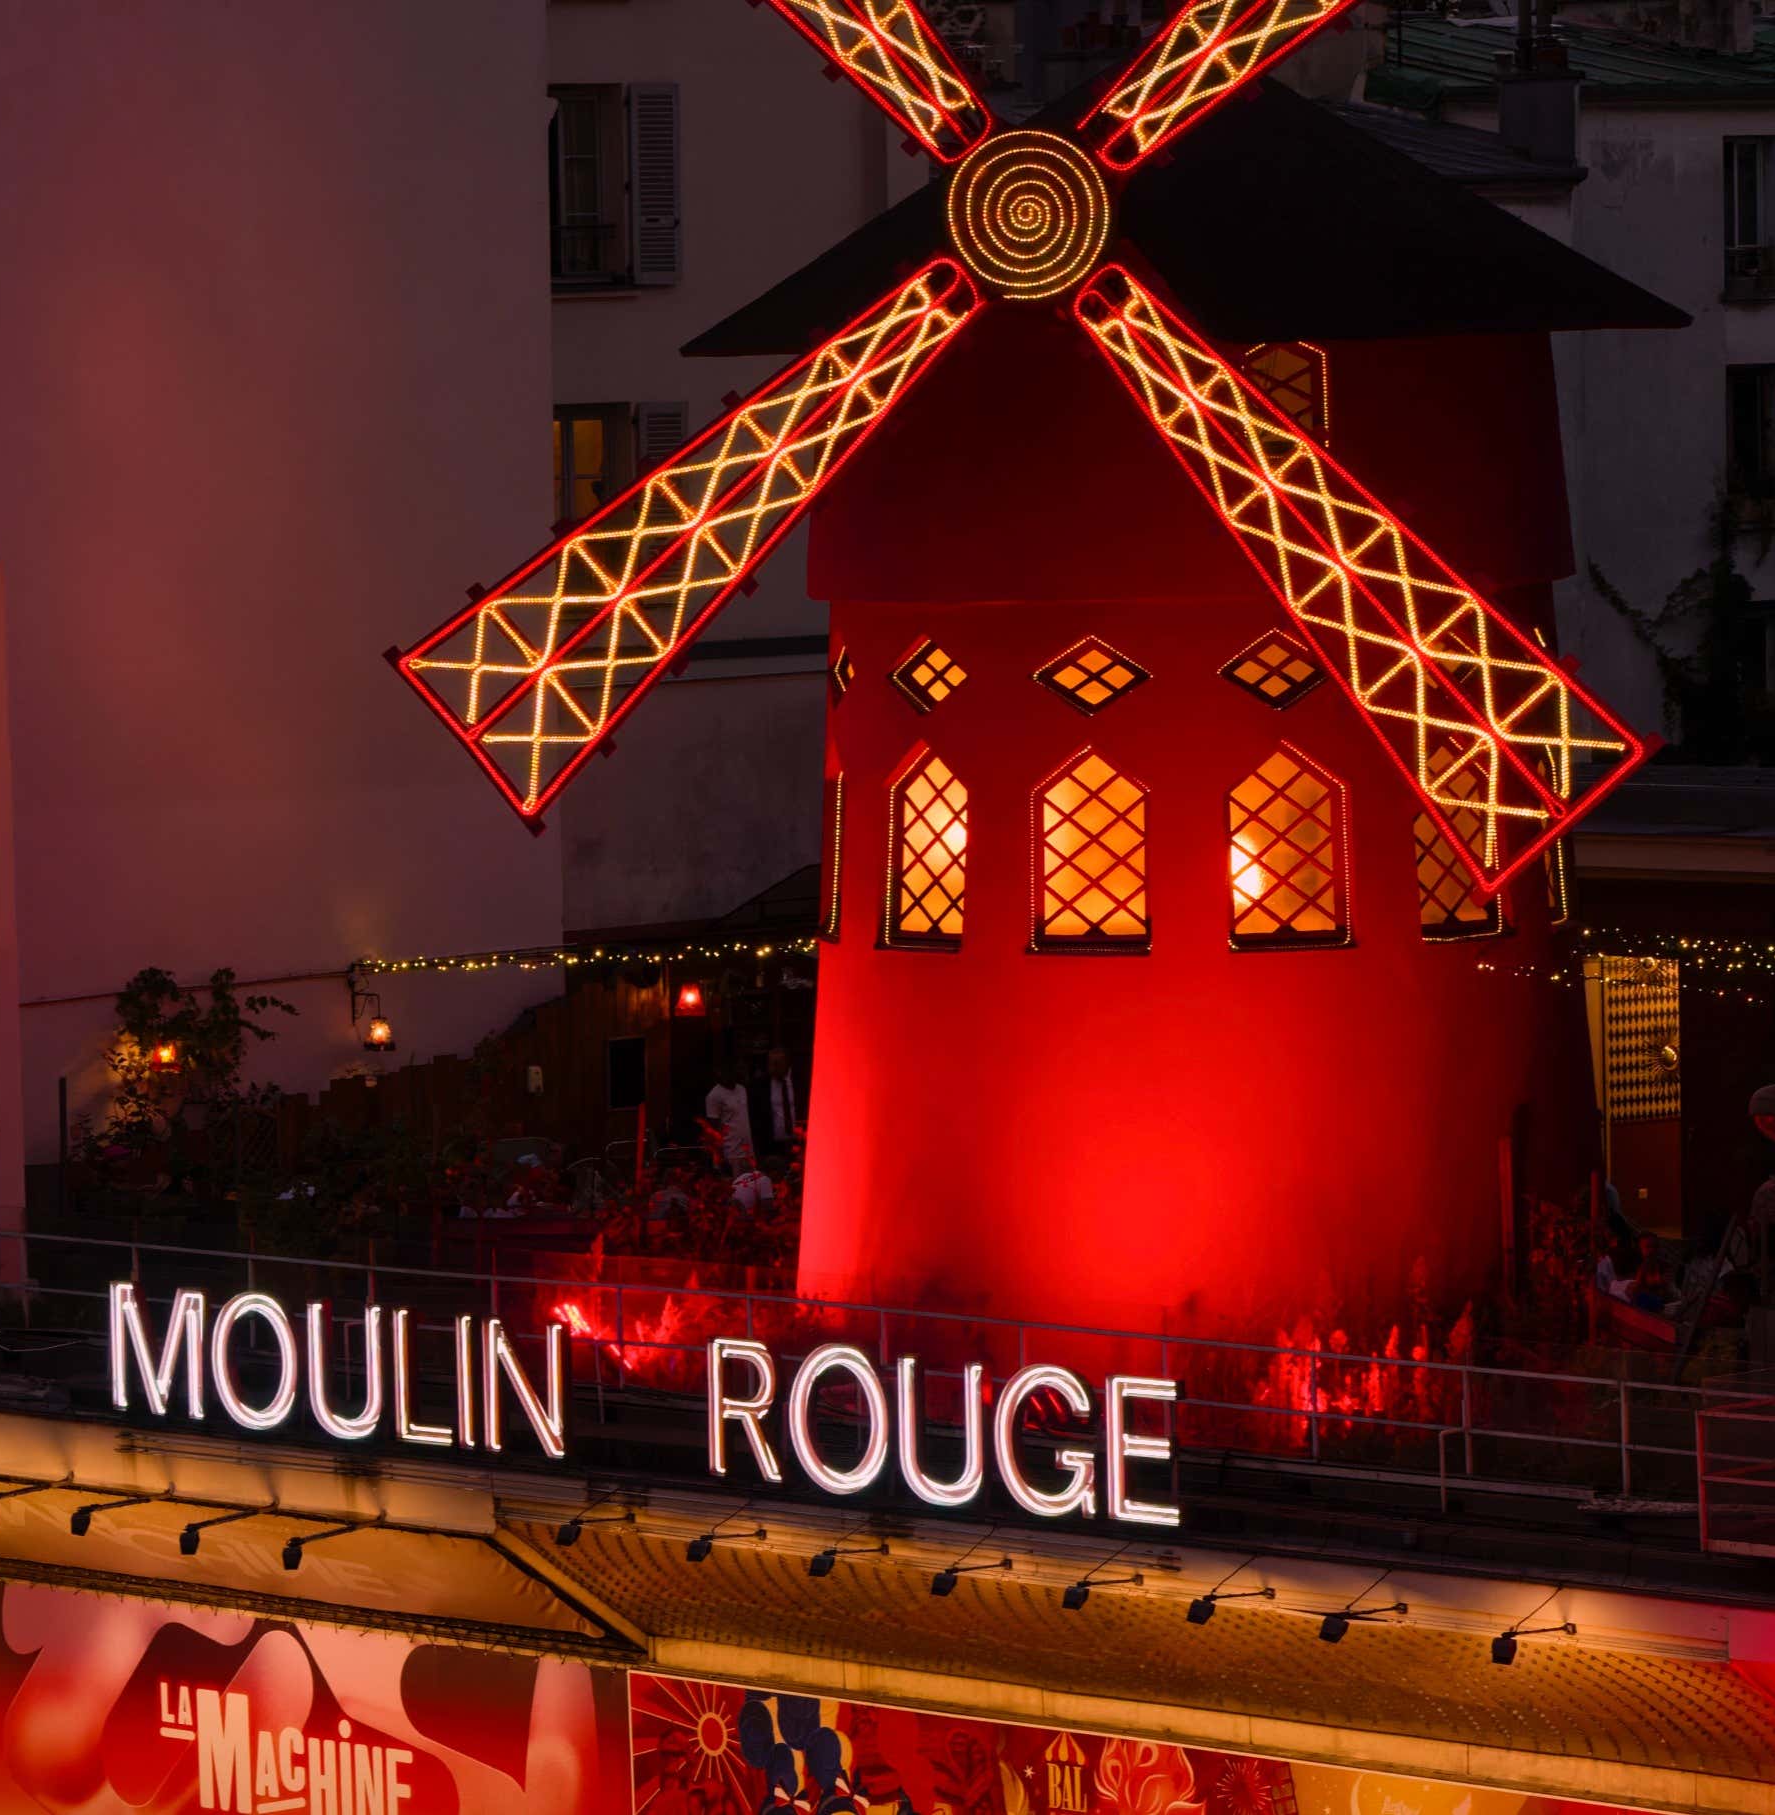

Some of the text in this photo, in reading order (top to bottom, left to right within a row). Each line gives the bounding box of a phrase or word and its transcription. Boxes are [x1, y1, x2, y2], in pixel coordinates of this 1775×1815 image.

[108, 1280, 1180, 1526] MOULIN ROUGE
[160, 1681, 194, 1728] LA
[1047, 1762, 1087, 1813] BAL
